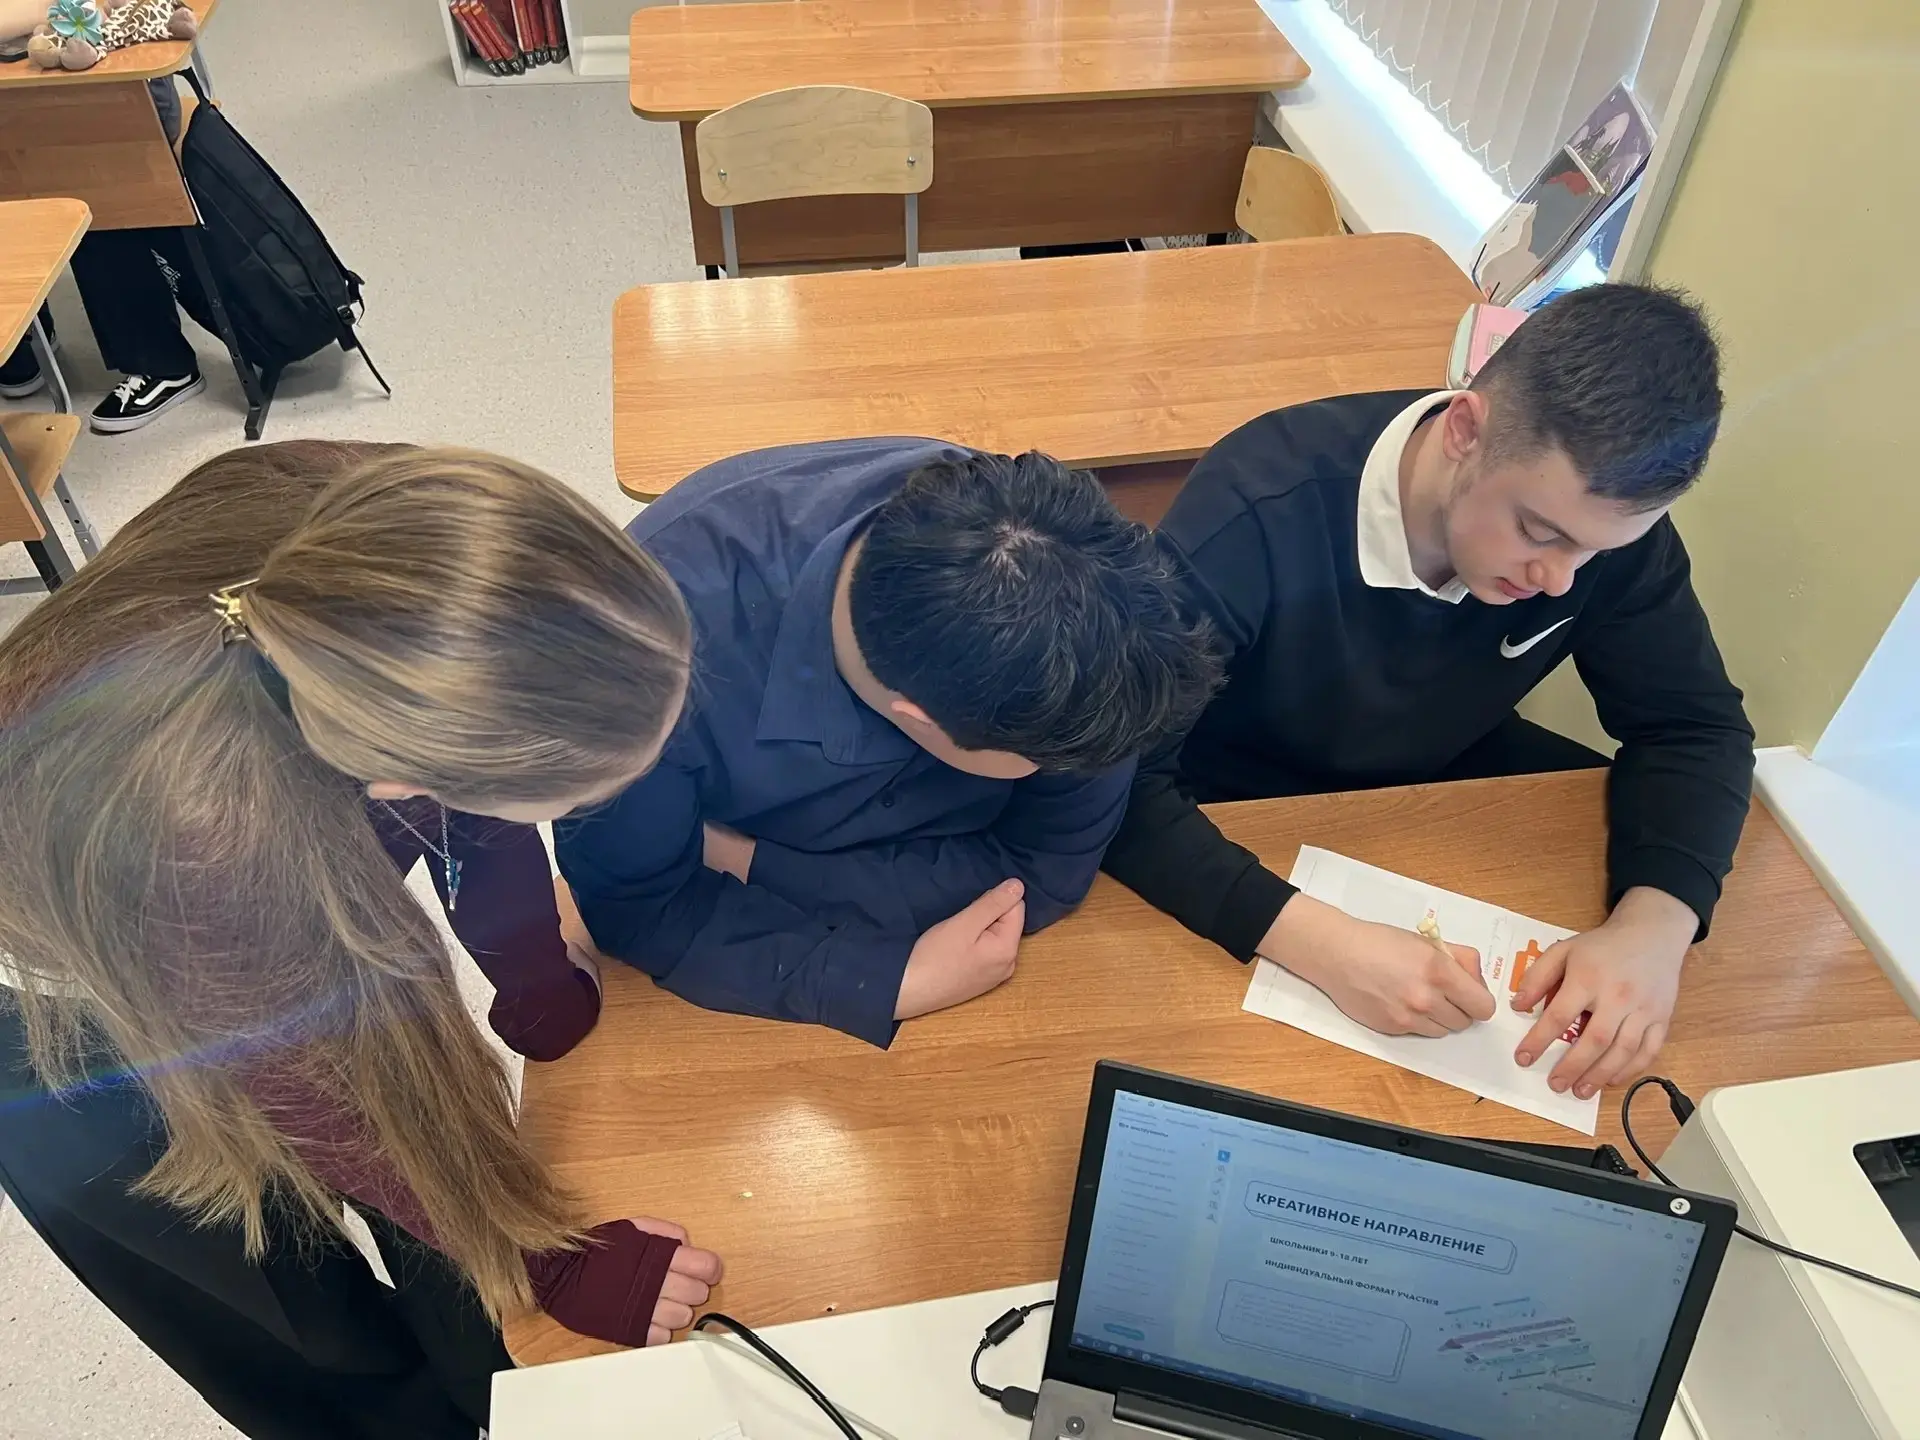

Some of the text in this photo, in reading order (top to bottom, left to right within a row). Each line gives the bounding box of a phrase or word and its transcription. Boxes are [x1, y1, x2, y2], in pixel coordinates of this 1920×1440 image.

[1255, 1192, 1486, 1256] КРЕАТИВНОЕ НАПРАВЛЕНИЕ
[1674, 1201, 1683, 1210] 3
[1269, 1236, 1329, 1257] ШКОЛЬНИКИ
[1350, 1255, 1369, 1265] ЛЕТ
[1264, 1259, 1440, 1307] ИНДИВИДУАЛЬНЫЙ ФОРМАТ УЧАСТИЯ
